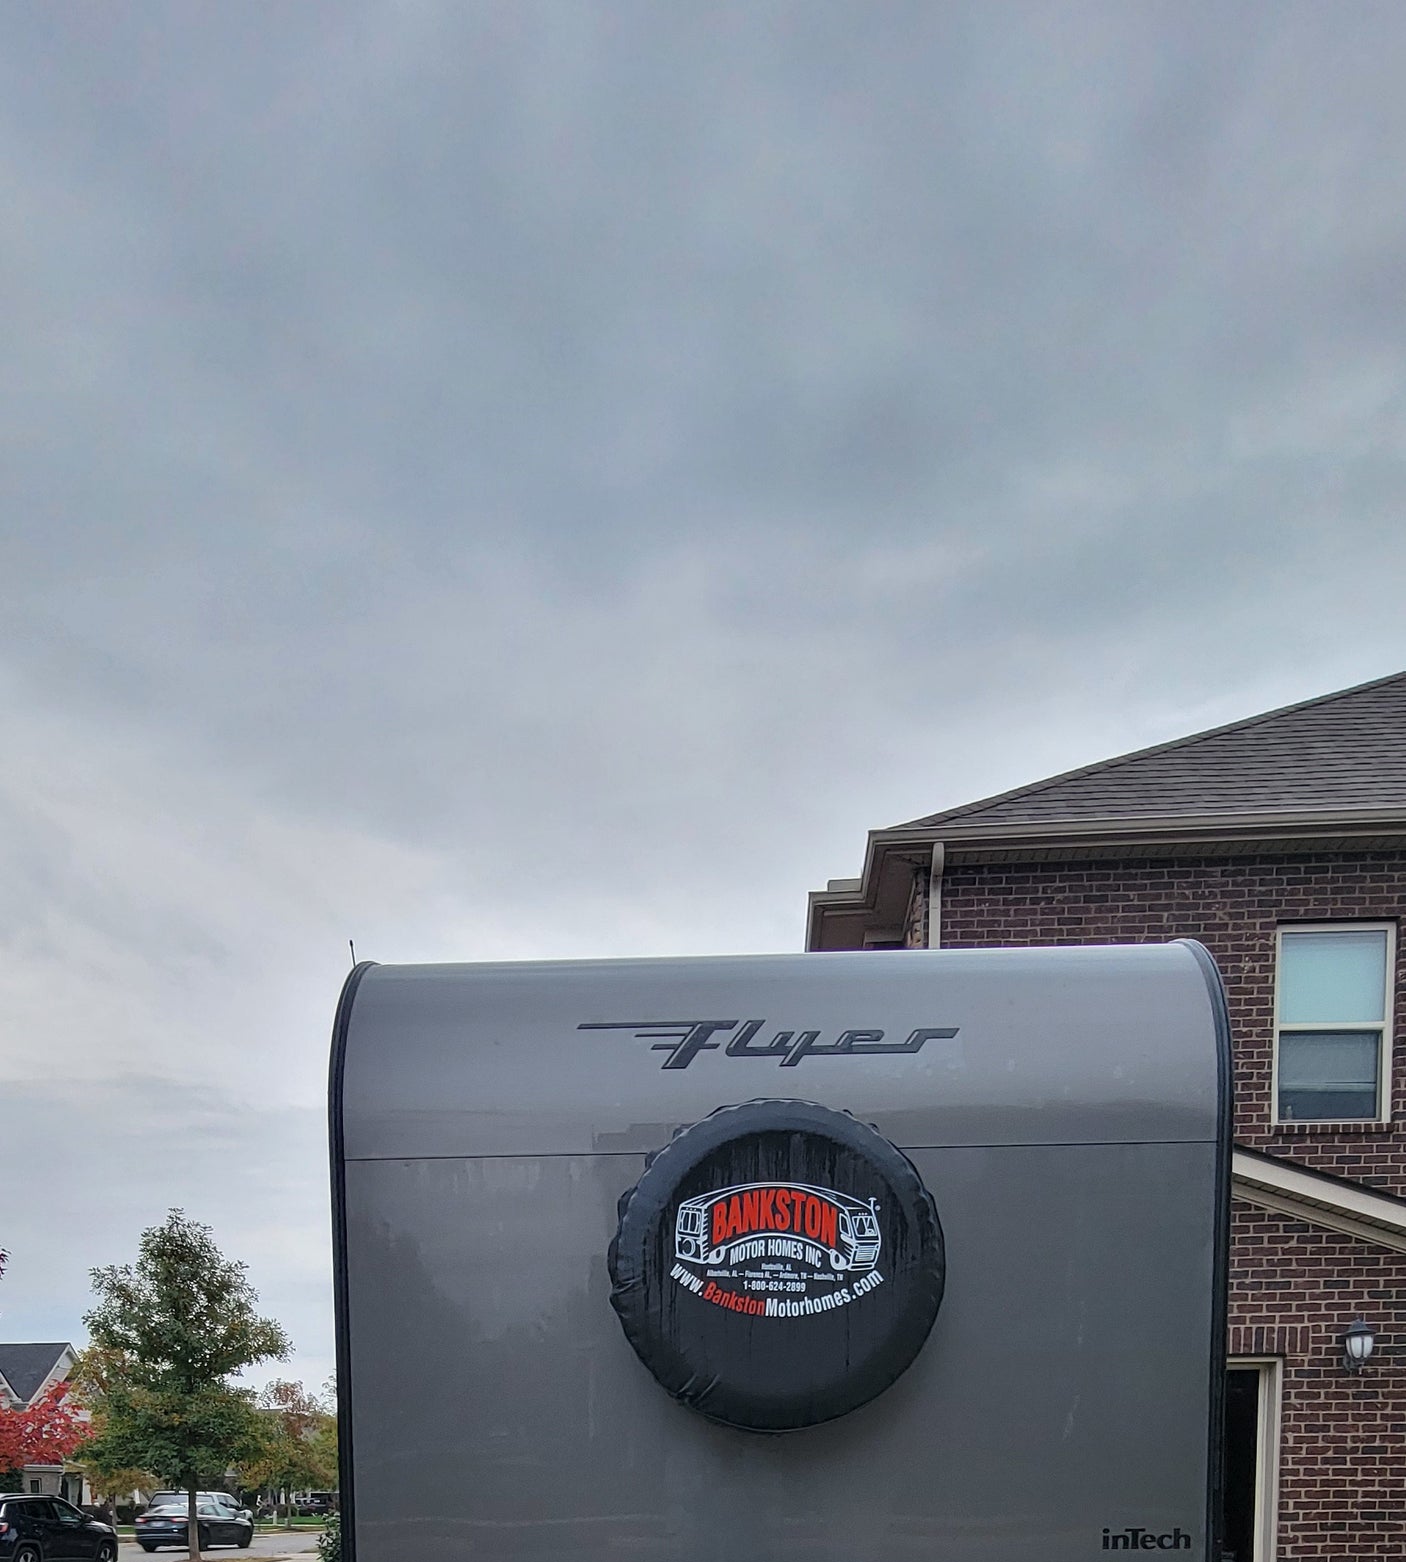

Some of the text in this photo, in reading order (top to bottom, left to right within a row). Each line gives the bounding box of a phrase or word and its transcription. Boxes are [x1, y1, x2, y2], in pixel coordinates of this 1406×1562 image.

[577, 1020, 960, 1070] Flyer
[712, 1188, 838, 1249] BANKSTON
[730, 1238, 822, 1269] MOTOR HOMES INC
[670, 1263, 884, 1318] www.BankstonMotorhomes.com
[743, 1280, 806, 1292] 1-800-624-2899
[1102, 1528, 1191, 1550] inTech
